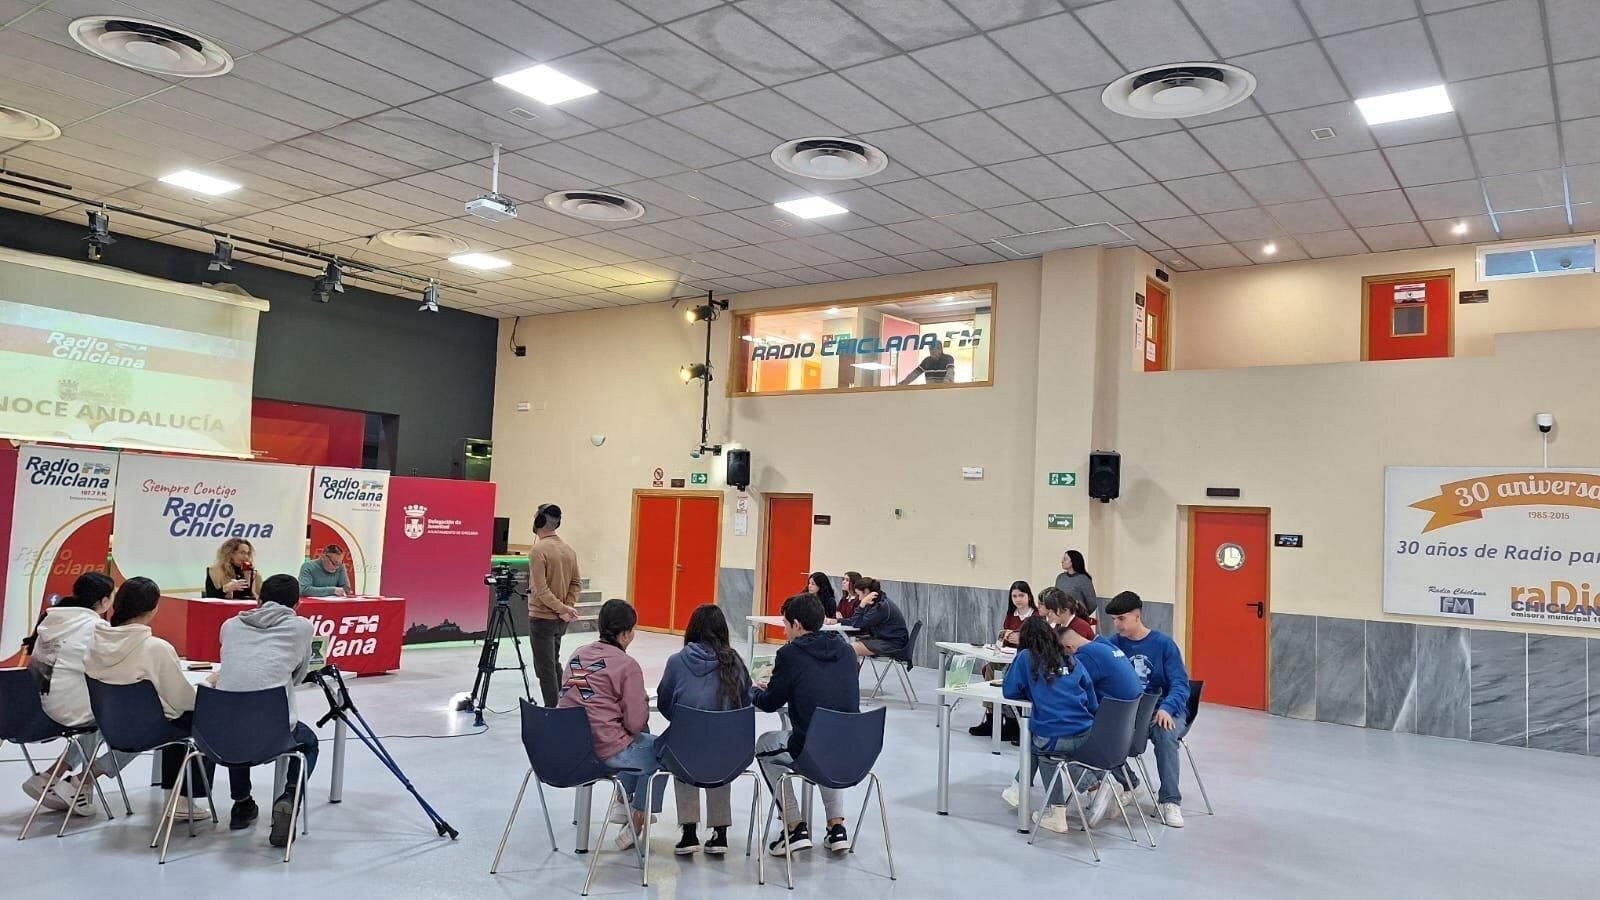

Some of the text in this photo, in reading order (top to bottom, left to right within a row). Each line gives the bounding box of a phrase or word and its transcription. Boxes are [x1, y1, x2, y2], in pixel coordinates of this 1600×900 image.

[47, 331, 108, 351] Radio
[752, 329, 982, 361] RADIO CHICLANA FM
[52, 345, 146, 369] Chiclana
[75, 403, 225, 433] ANDALUCÍA
[25, 456, 79, 474] Radio
[30, 471, 110, 488] Chiclana
[142, 478, 239, 499] Siempre Contigo
[319, 476, 360, 491] Radio
[323, 488, 383, 501] Chiclana
[1455, 481, 1490, 507] 30
[162, 496, 234, 521] Radio
[1528, 511, 1570, 520] 1985-2015
[170, 516, 274, 538] Chiclana
[1396, 540, 1420, 555] 30
[1425, 541, 1468, 558] años
[1474, 543, 1498, 559] de
[1504, 545, 1562, 562] Radio
[1428, 585, 1487, 596] Radio Chiclana
[1511, 581, 1600, 611] raDi
[1441, 598, 1473, 614] FM
[339, 615, 379, 634] FM
[1511, 611, 1545, 619] emisora
[1547, 614, 1591, 622] municipal
